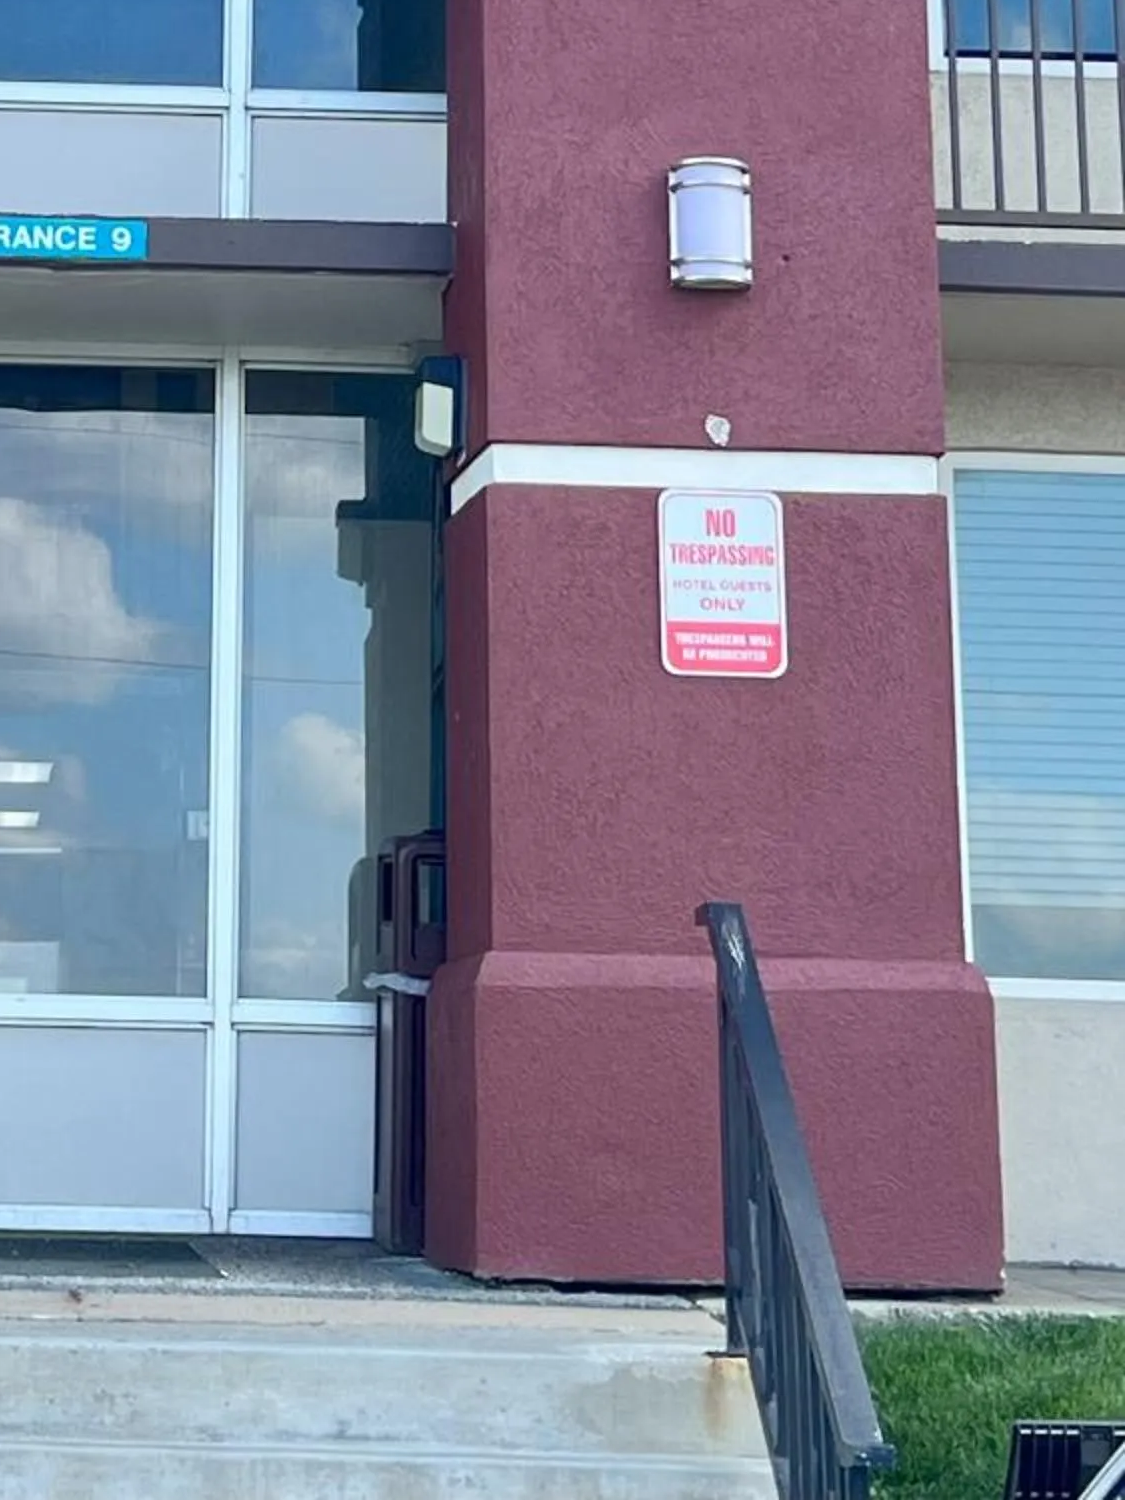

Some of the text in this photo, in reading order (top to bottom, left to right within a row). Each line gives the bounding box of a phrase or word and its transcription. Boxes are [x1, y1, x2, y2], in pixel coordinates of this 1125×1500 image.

[111, 226, 132, 252] 9
[704, 508, 737, 538] NO
[669, 543, 775, 567] TRESPASSING
[672, 579, 772, 593] HOTEL GUESTS
[699, 597, 746, 612] ONLY
